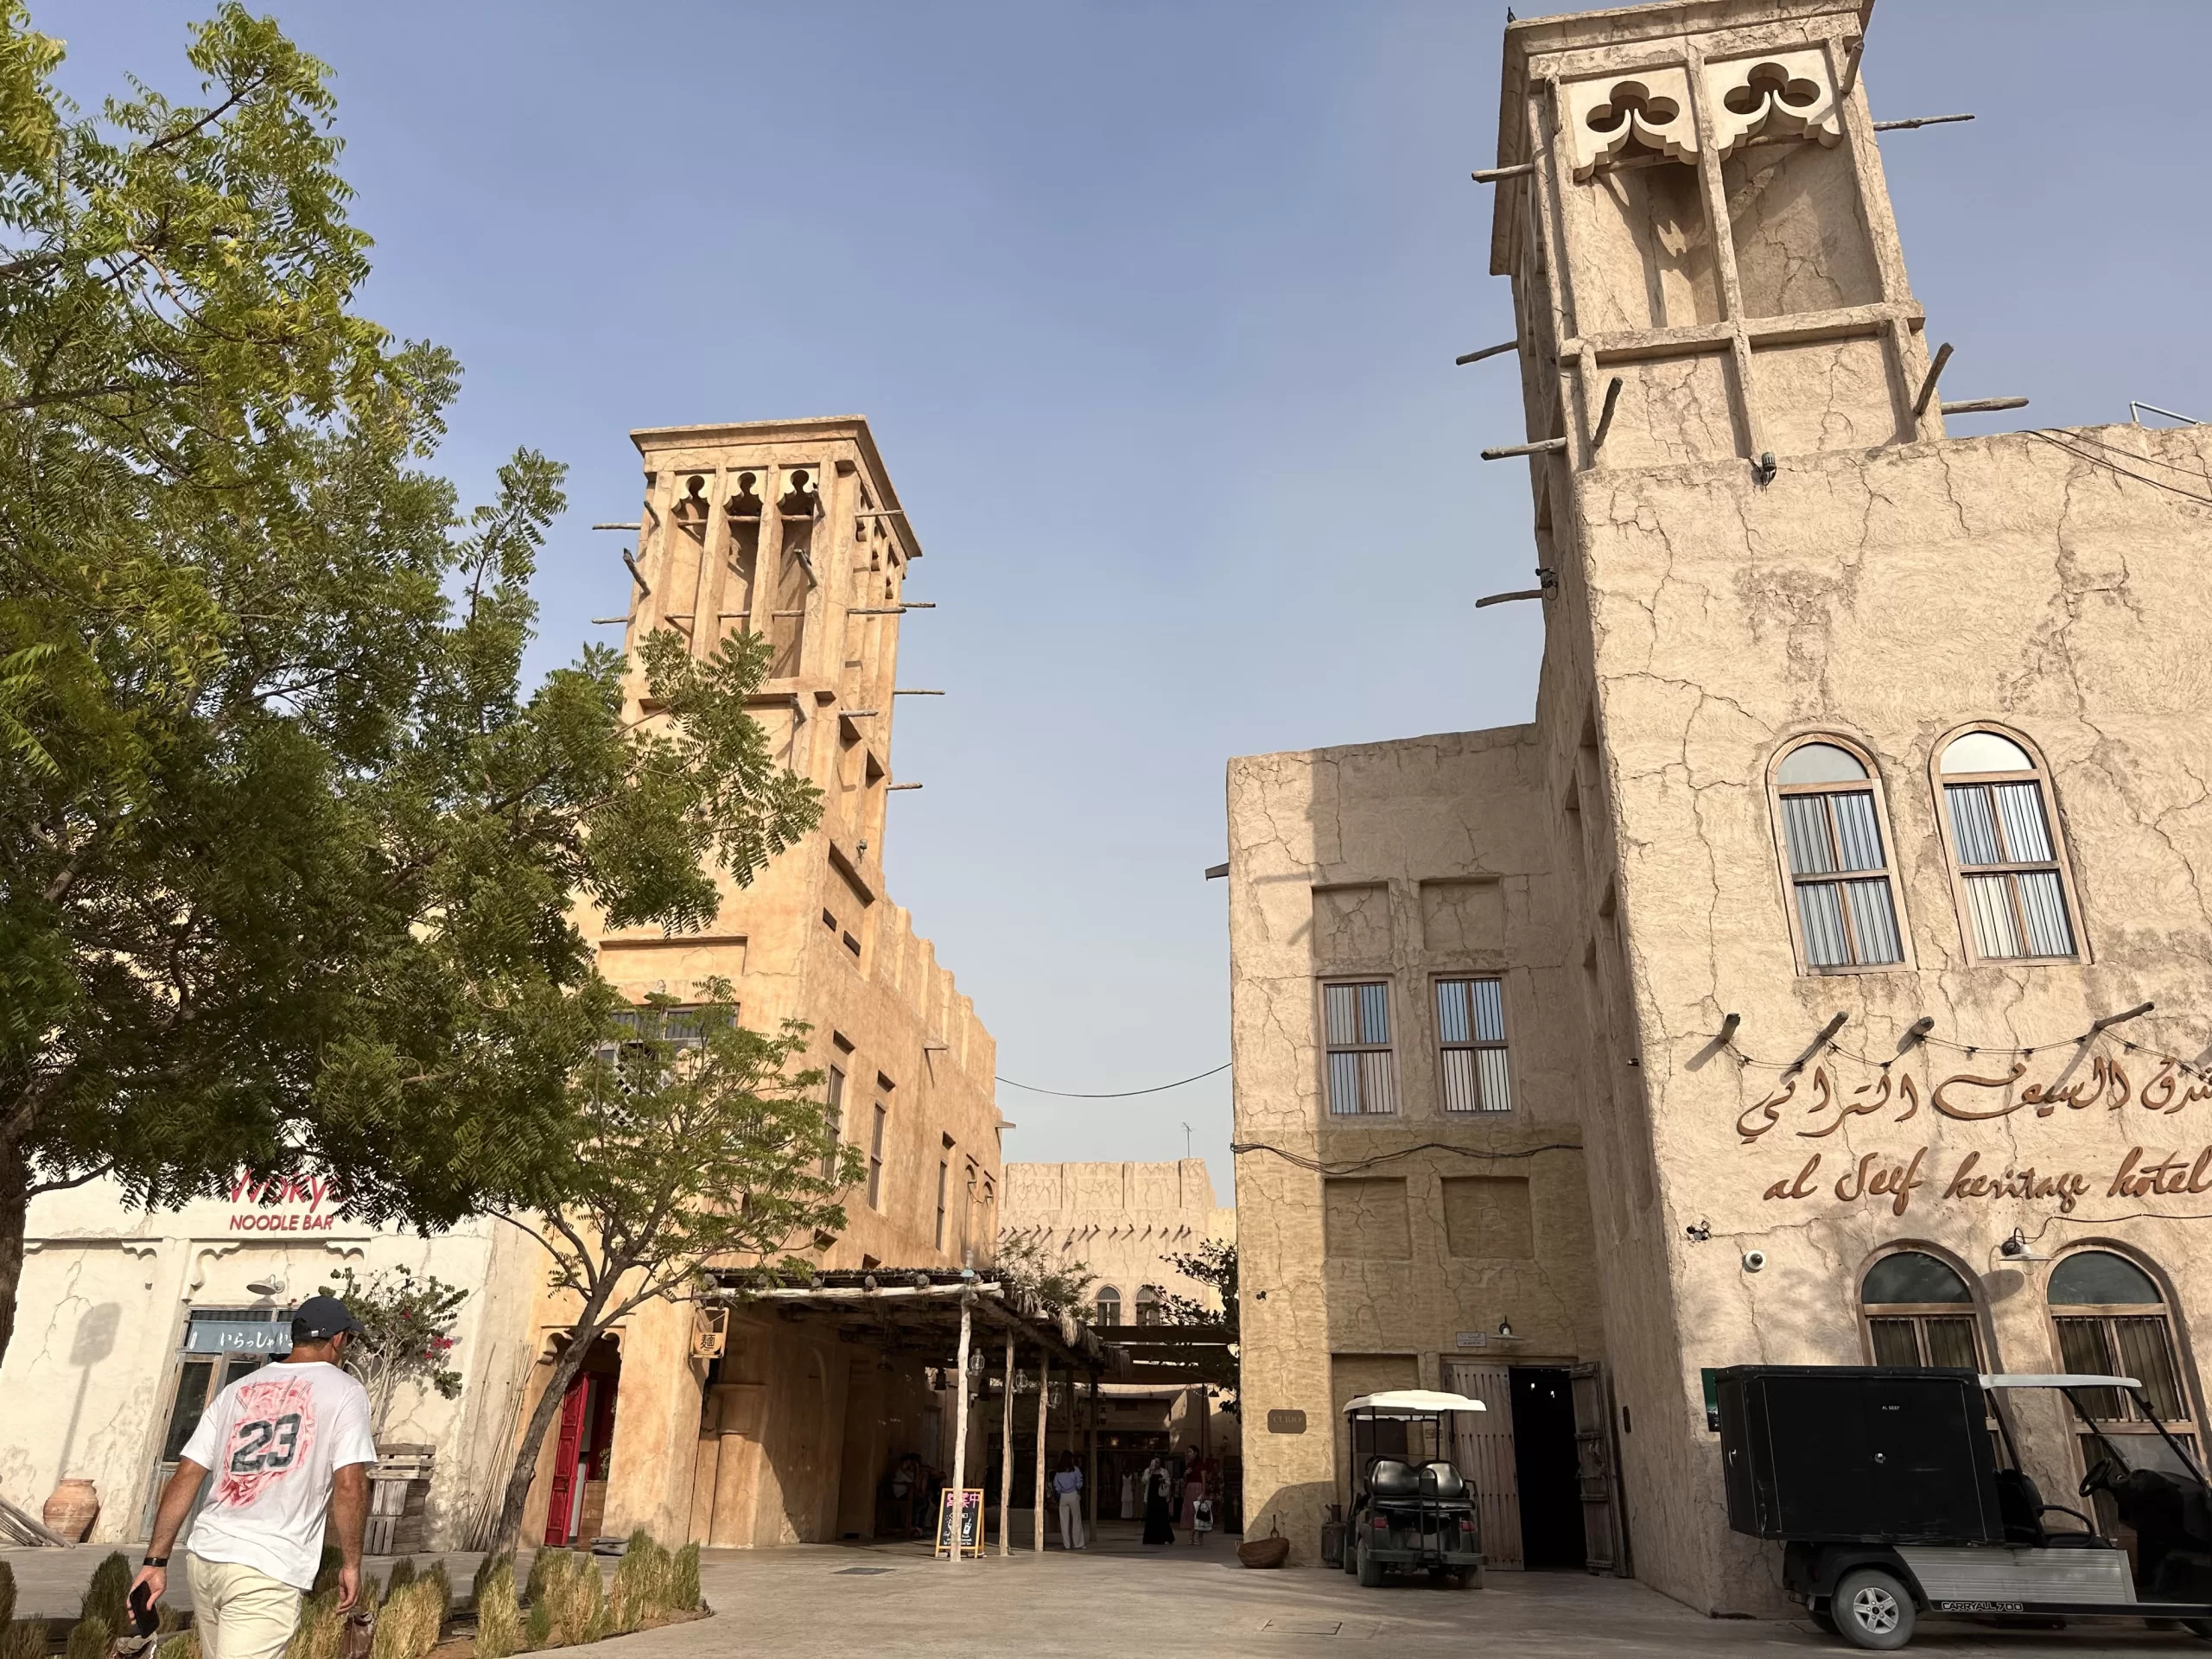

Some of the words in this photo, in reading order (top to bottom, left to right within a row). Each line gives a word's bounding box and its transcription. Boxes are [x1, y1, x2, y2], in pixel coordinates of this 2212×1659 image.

[1932, 1055, 2132, 1121] السيف
[1764, 1153, 1821, 1200] al
[1942, 1150, 2091, 1214] heritage
[2106, 1144, 2212, 1198] hotel
[229, 1214, 301, 1231] NOODLE
[302, 1214, 334, 1231] BAR
[230, 1413, 302, 1473] 23
[1941, 1601, 1997, 1611] CARRYALL
[1996, 1602, 2024, 1612] 700
